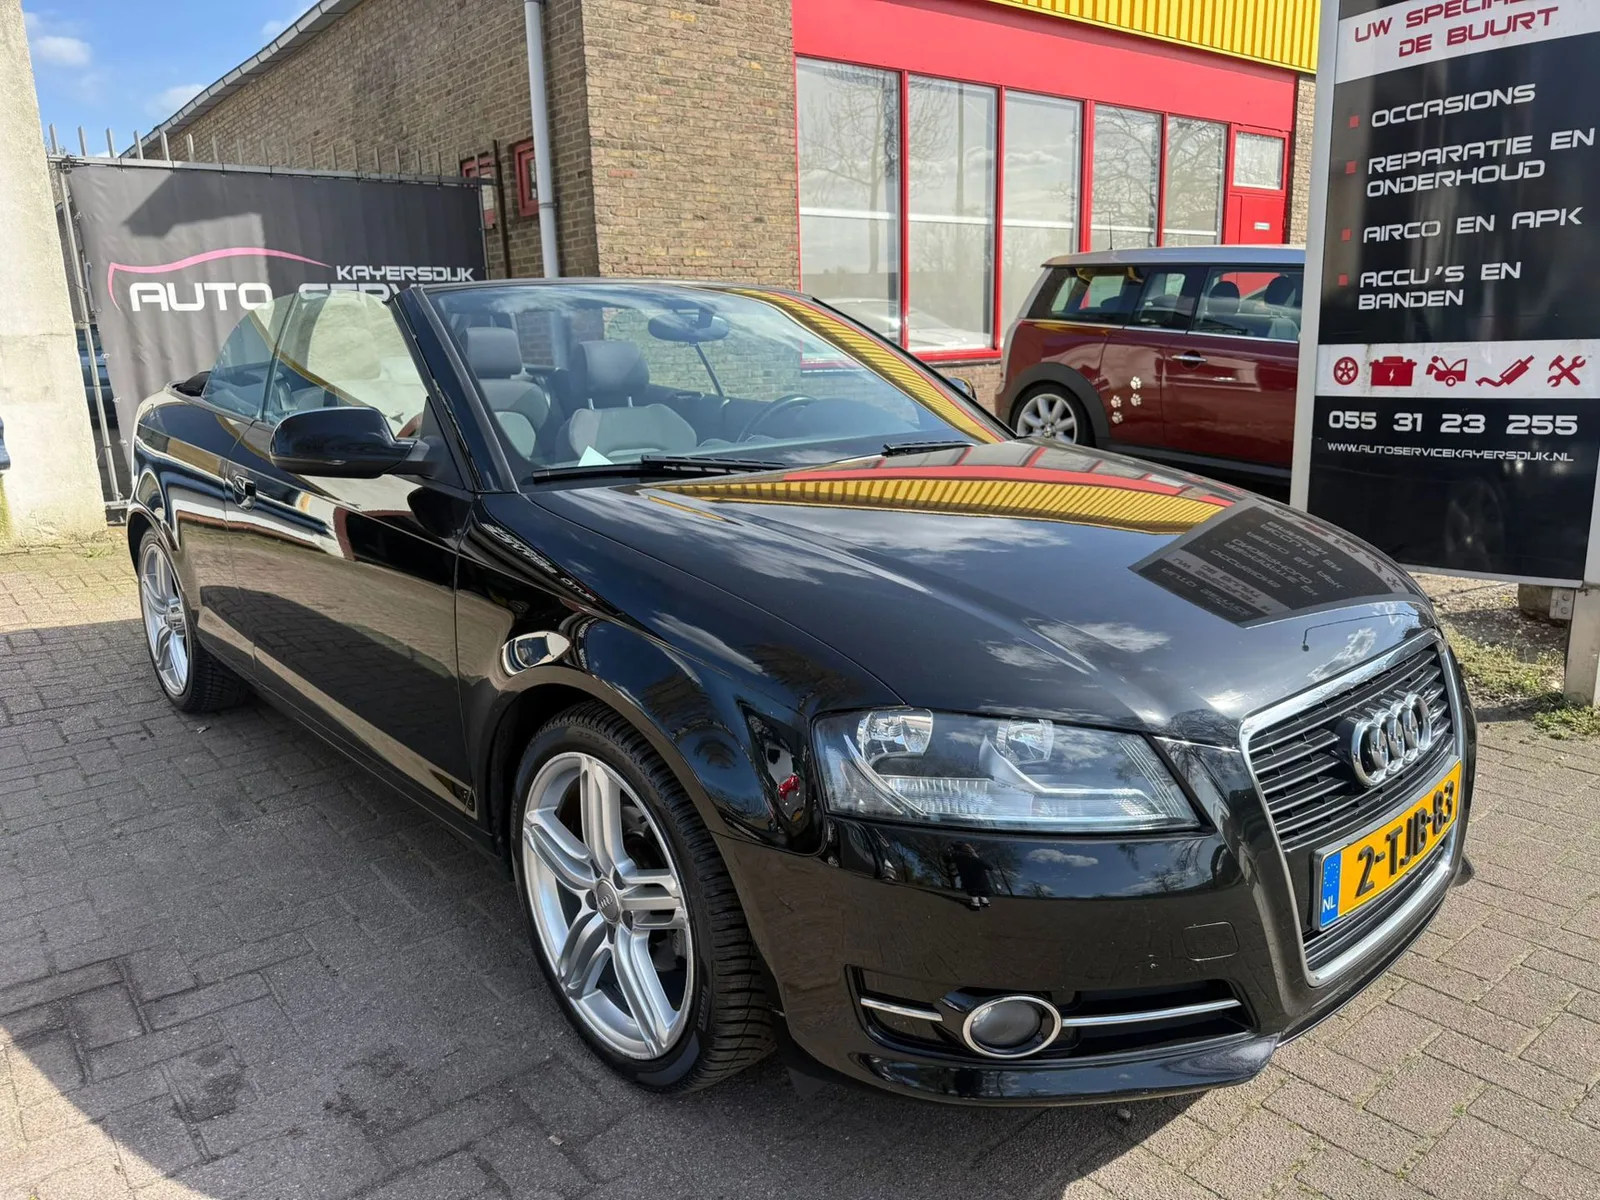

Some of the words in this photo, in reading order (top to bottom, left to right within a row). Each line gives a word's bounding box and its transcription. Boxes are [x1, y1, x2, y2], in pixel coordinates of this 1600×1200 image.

[1354, 16, 1393, 43] UW
[1405, 0, 1530, 29] SPECI
[1398, 33, 1433, 58] DE
[1446, 6, 1559, 47] BUURT
[1371, 83, 1536, 128] OCCASIONS
[1368, 135, 1534, 175] REPARATIE
[1550, 127, 1595, 151] EN
[1366, 160, 1546, 198] ONDERHOUD
[1363, 219, 1441, 244] AIRCO
[1455, 214, 1496, 235] EN
[1511, 206, 1584, 231] APK
[335, 265, 475, 283] KAYERSDIJK
[1359, 265, 1465, 288] ACCU'S
[1480, 261, 1522, 281] EN
[128, 282, 273, 312] AUTO
[1358, 289, 1465, 311] BANDEN
[1328, 410, 1377, 430] 055
[1393, 412, 1424, 432] 31
[1439, 413, 1486, 434] 23
[1505, 415, 1578, 436] 255
[1327, 441, 1574, 463] WWW.AUTOSERVICEKAYERSDIJK.NL
[1355, 780, 1455, 899] 2-TJB-83
[1322, 896, 1337, 913] NL
